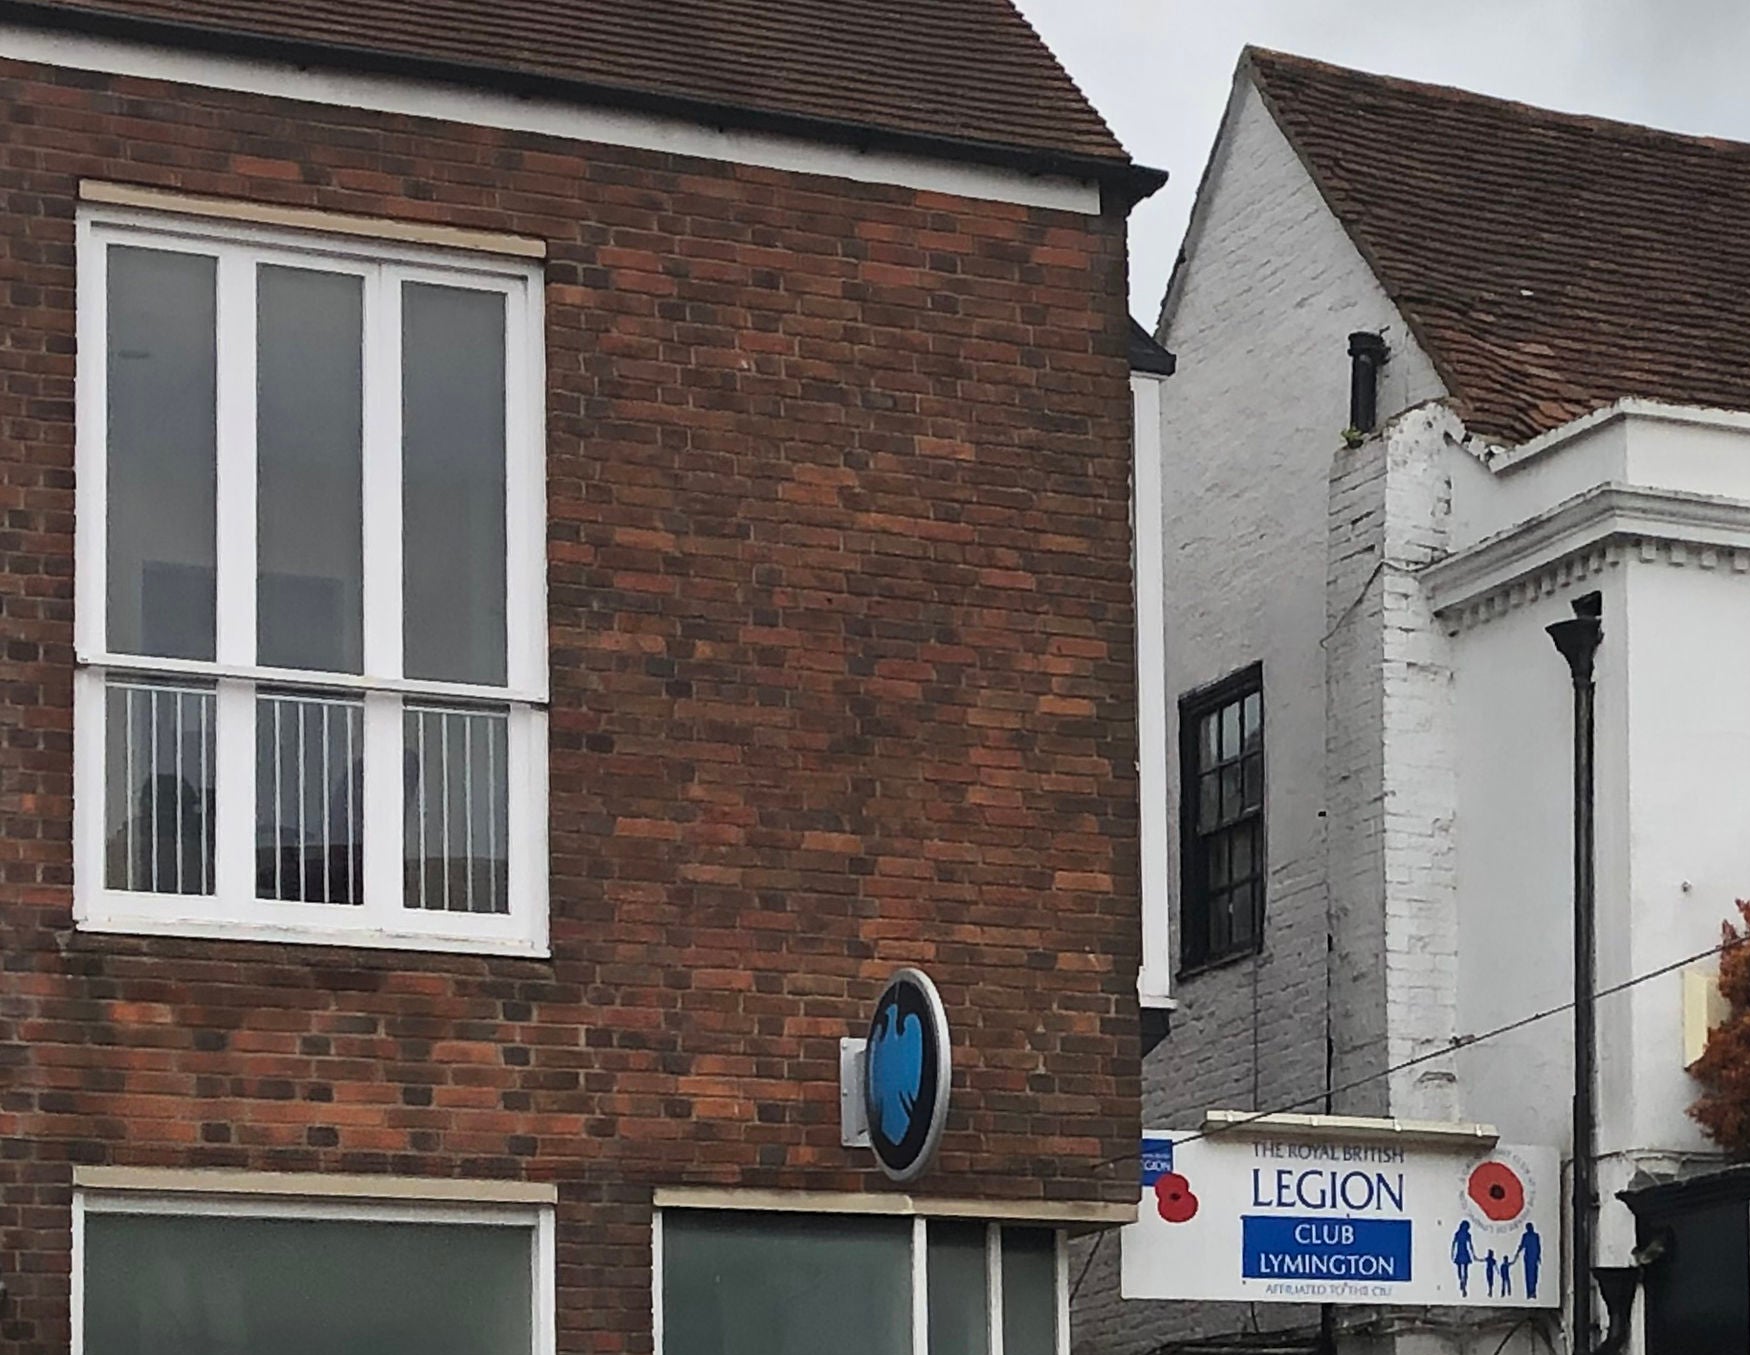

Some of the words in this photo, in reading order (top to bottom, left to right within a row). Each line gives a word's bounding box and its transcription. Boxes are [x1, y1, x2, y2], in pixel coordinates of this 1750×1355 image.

[1254, 1141, 1285, 1159] THE
[1289, 1143, 1340, 1162] ROYAL
[1343, 1144, 1405, 1164] BRITISH
[1251, 1167, 1405, 1212] LEGION
[1294, 1223, 1355, 1246] CLUB
[1259, 1254, 1395, 1276] LYMINGTON
